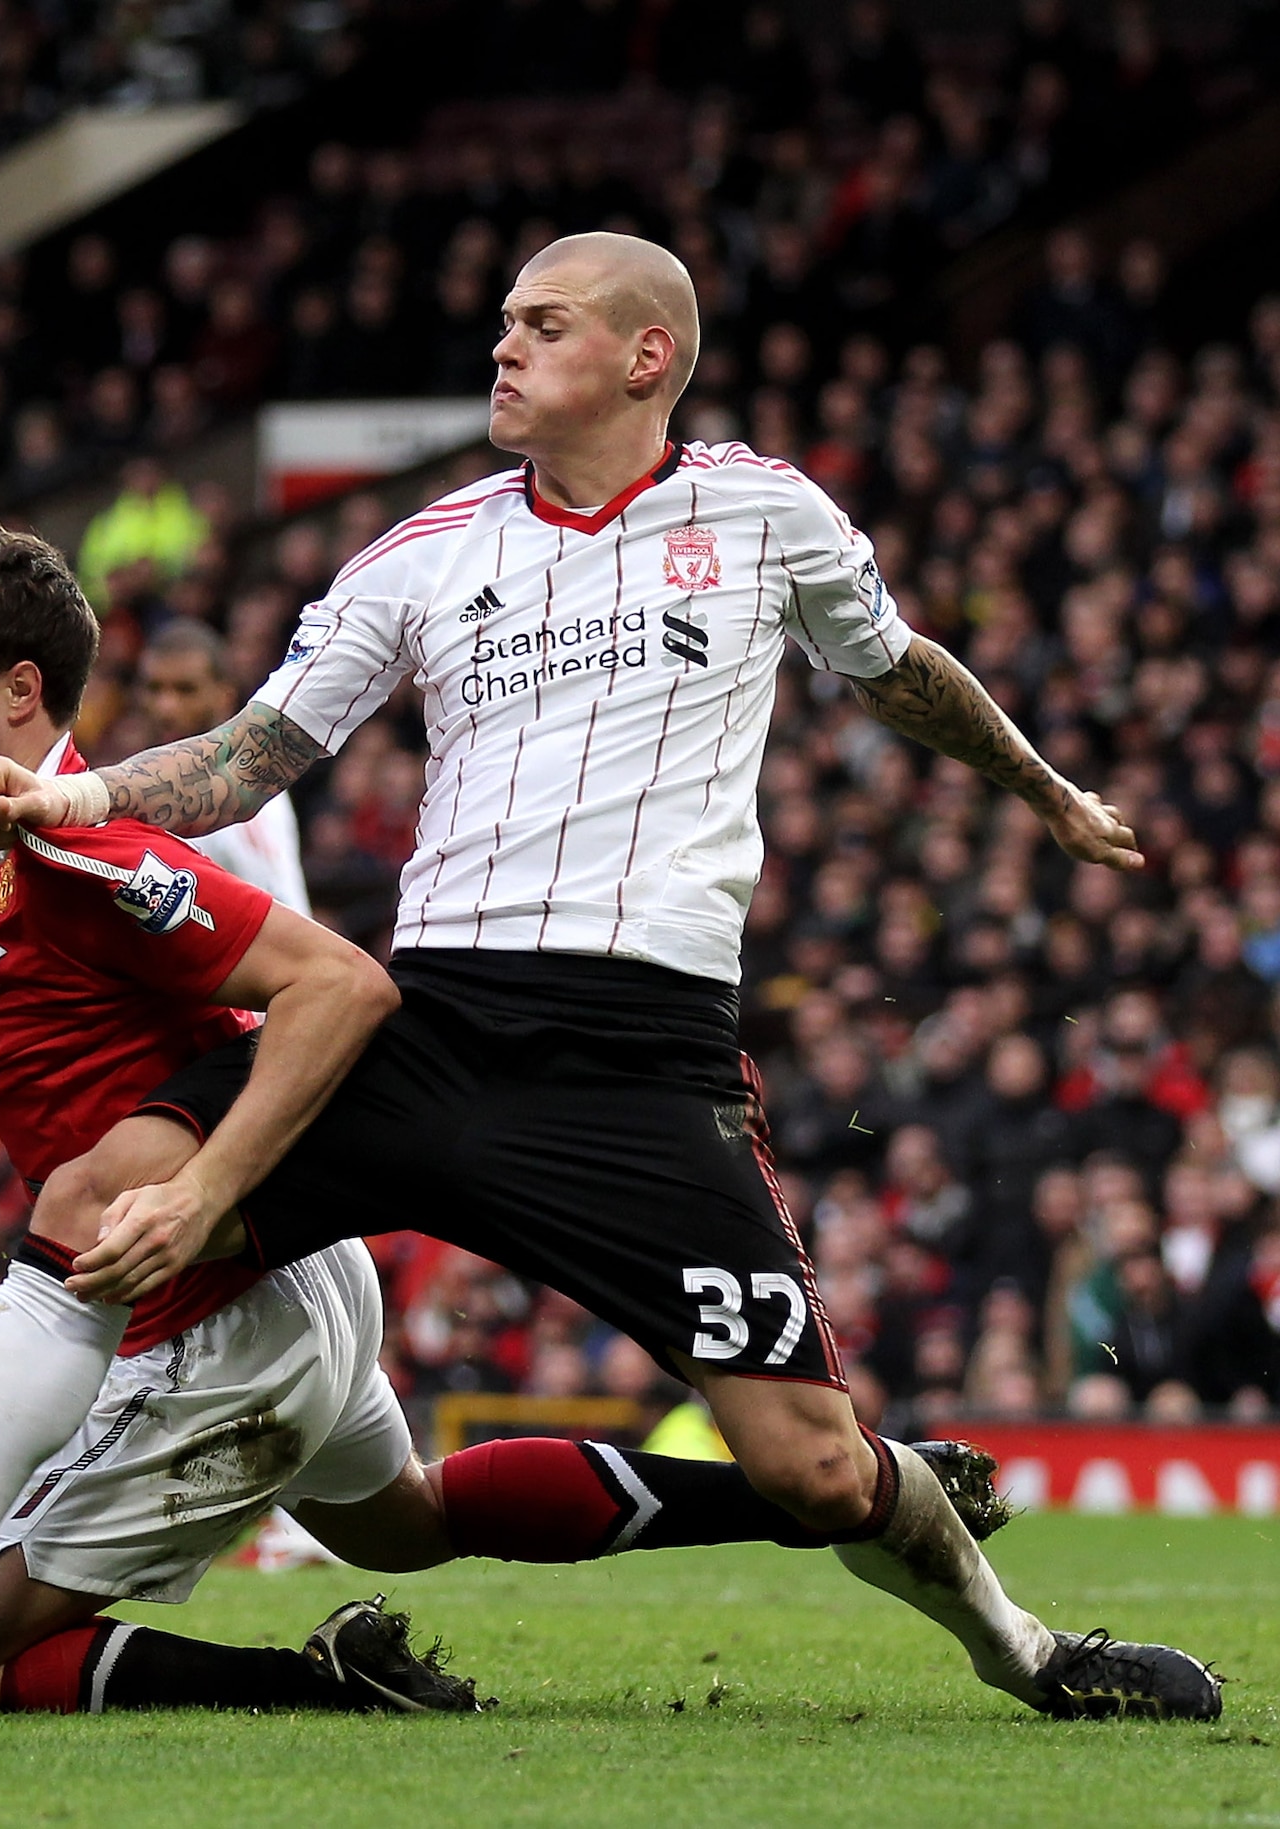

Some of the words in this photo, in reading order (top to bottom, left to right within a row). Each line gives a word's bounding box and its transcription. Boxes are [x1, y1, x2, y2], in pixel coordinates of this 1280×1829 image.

[671, 546, 711, 555] LIVERPOOL
[470, 606, 646, 664] Standard
[461, 638, 646, 706] Chartered
[682, 1267, 808, 1365] 37
